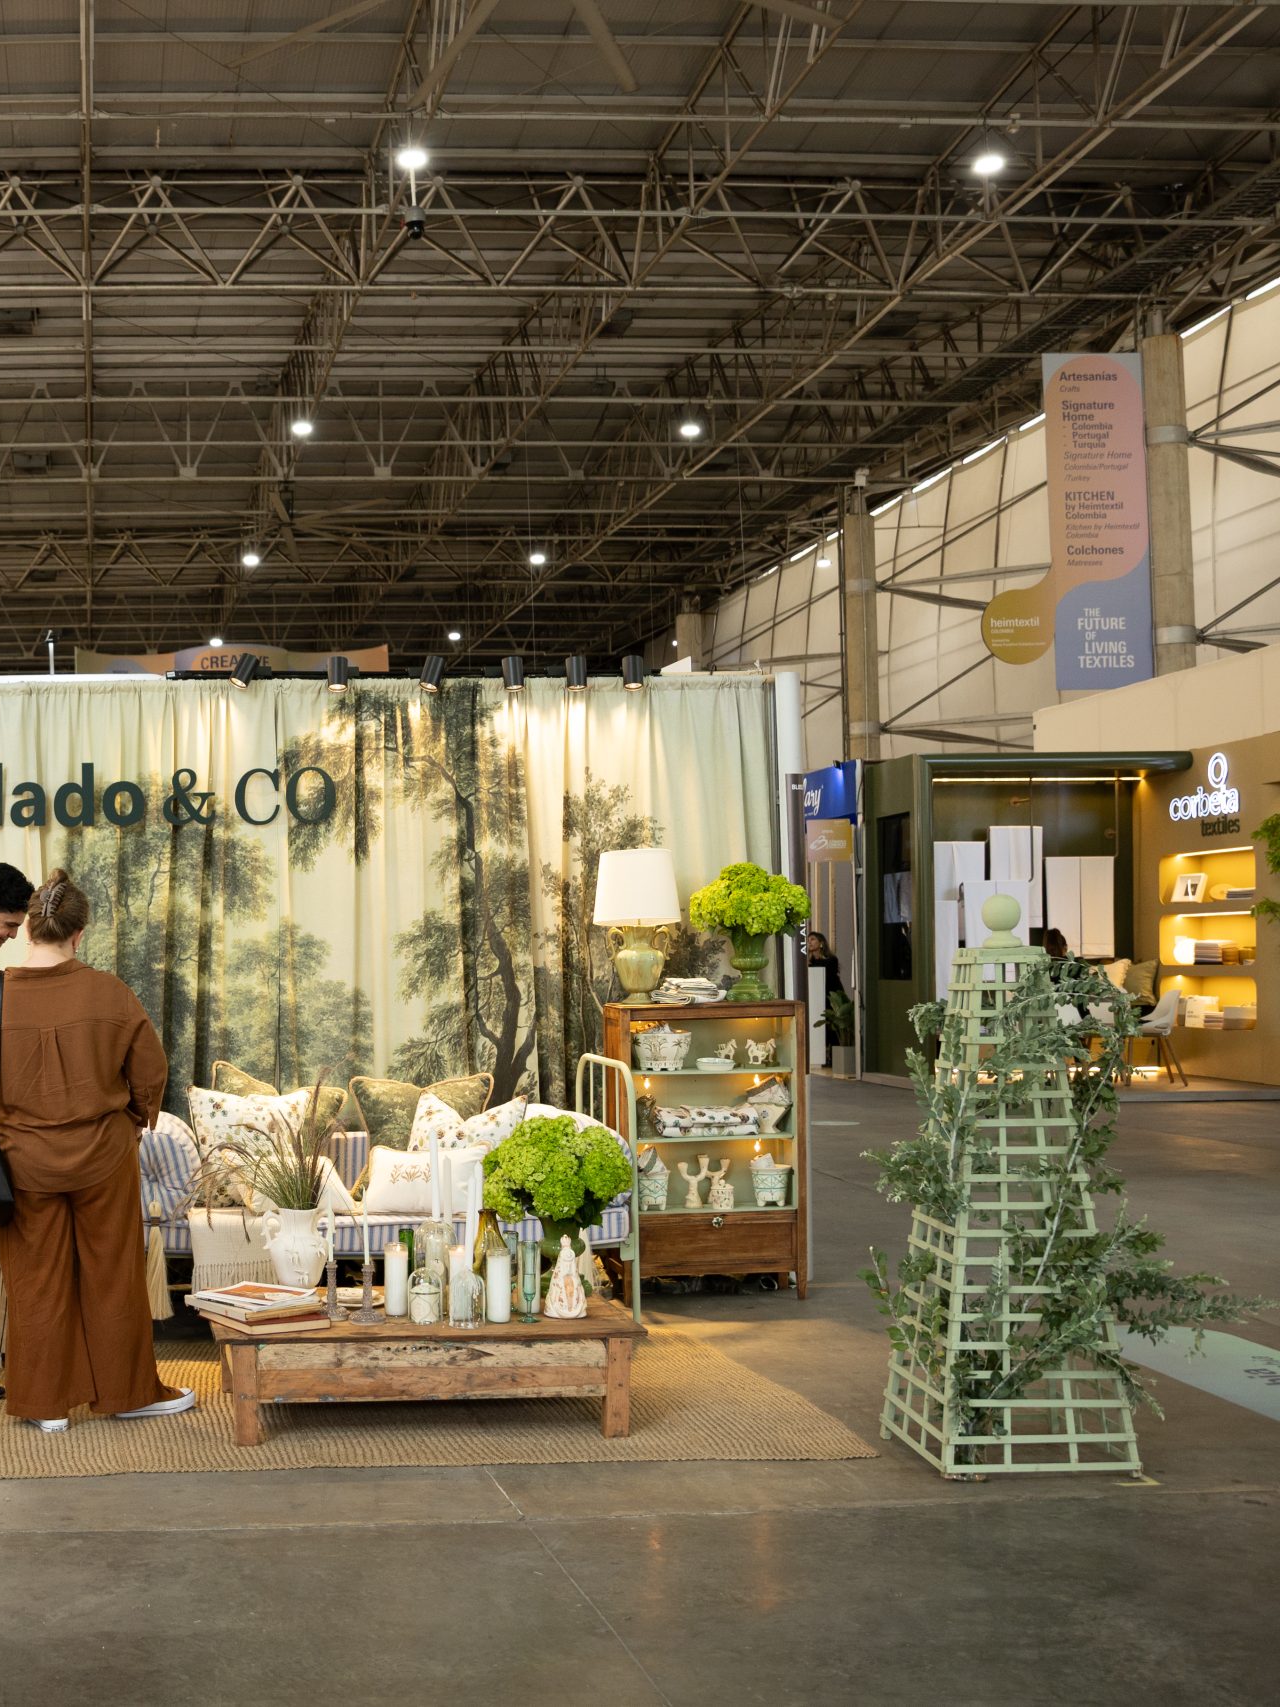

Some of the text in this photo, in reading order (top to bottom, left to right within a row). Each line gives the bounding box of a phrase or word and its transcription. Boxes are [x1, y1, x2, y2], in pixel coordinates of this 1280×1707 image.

[1059, 371, 1118, 381] Artesanías
[1060, 385, 1080, 393] Crafts
[1062, 400, 1115, 412] Signature
[1062, 412, 1095, 422] Home
[1071, 422, 1113, 431] Colombia
[1072, 431, 1110, 441] Portugal
[1064, 450, 1133, 461] Signature Home
[1065, 491, 1115, 501] KITCHEN
[1065, 502, 1124, 512] by Heimtextil
[1065, 511, 1107, 519] Colombia
[1067, 545, 1125, 556] Colchones
[1083, 608, 1101, 617] THE
[991, 616, 1040, 627] heimtextil
[1078, 617, 1126, 630] FUTURE
[1085, 631, 1097, 640] OF
[1085, 641, 1127, 654] LIVING
[200, 655, 270, 670] CREAVE
[1078, 655, 1135, 668] TEXTILES
[162, 767, 217, 827] &
[234, 765, 338, 827] CO
[1169, 785, 1239, 821] corbeta
[1201, 815, 1240, 837] textiles
